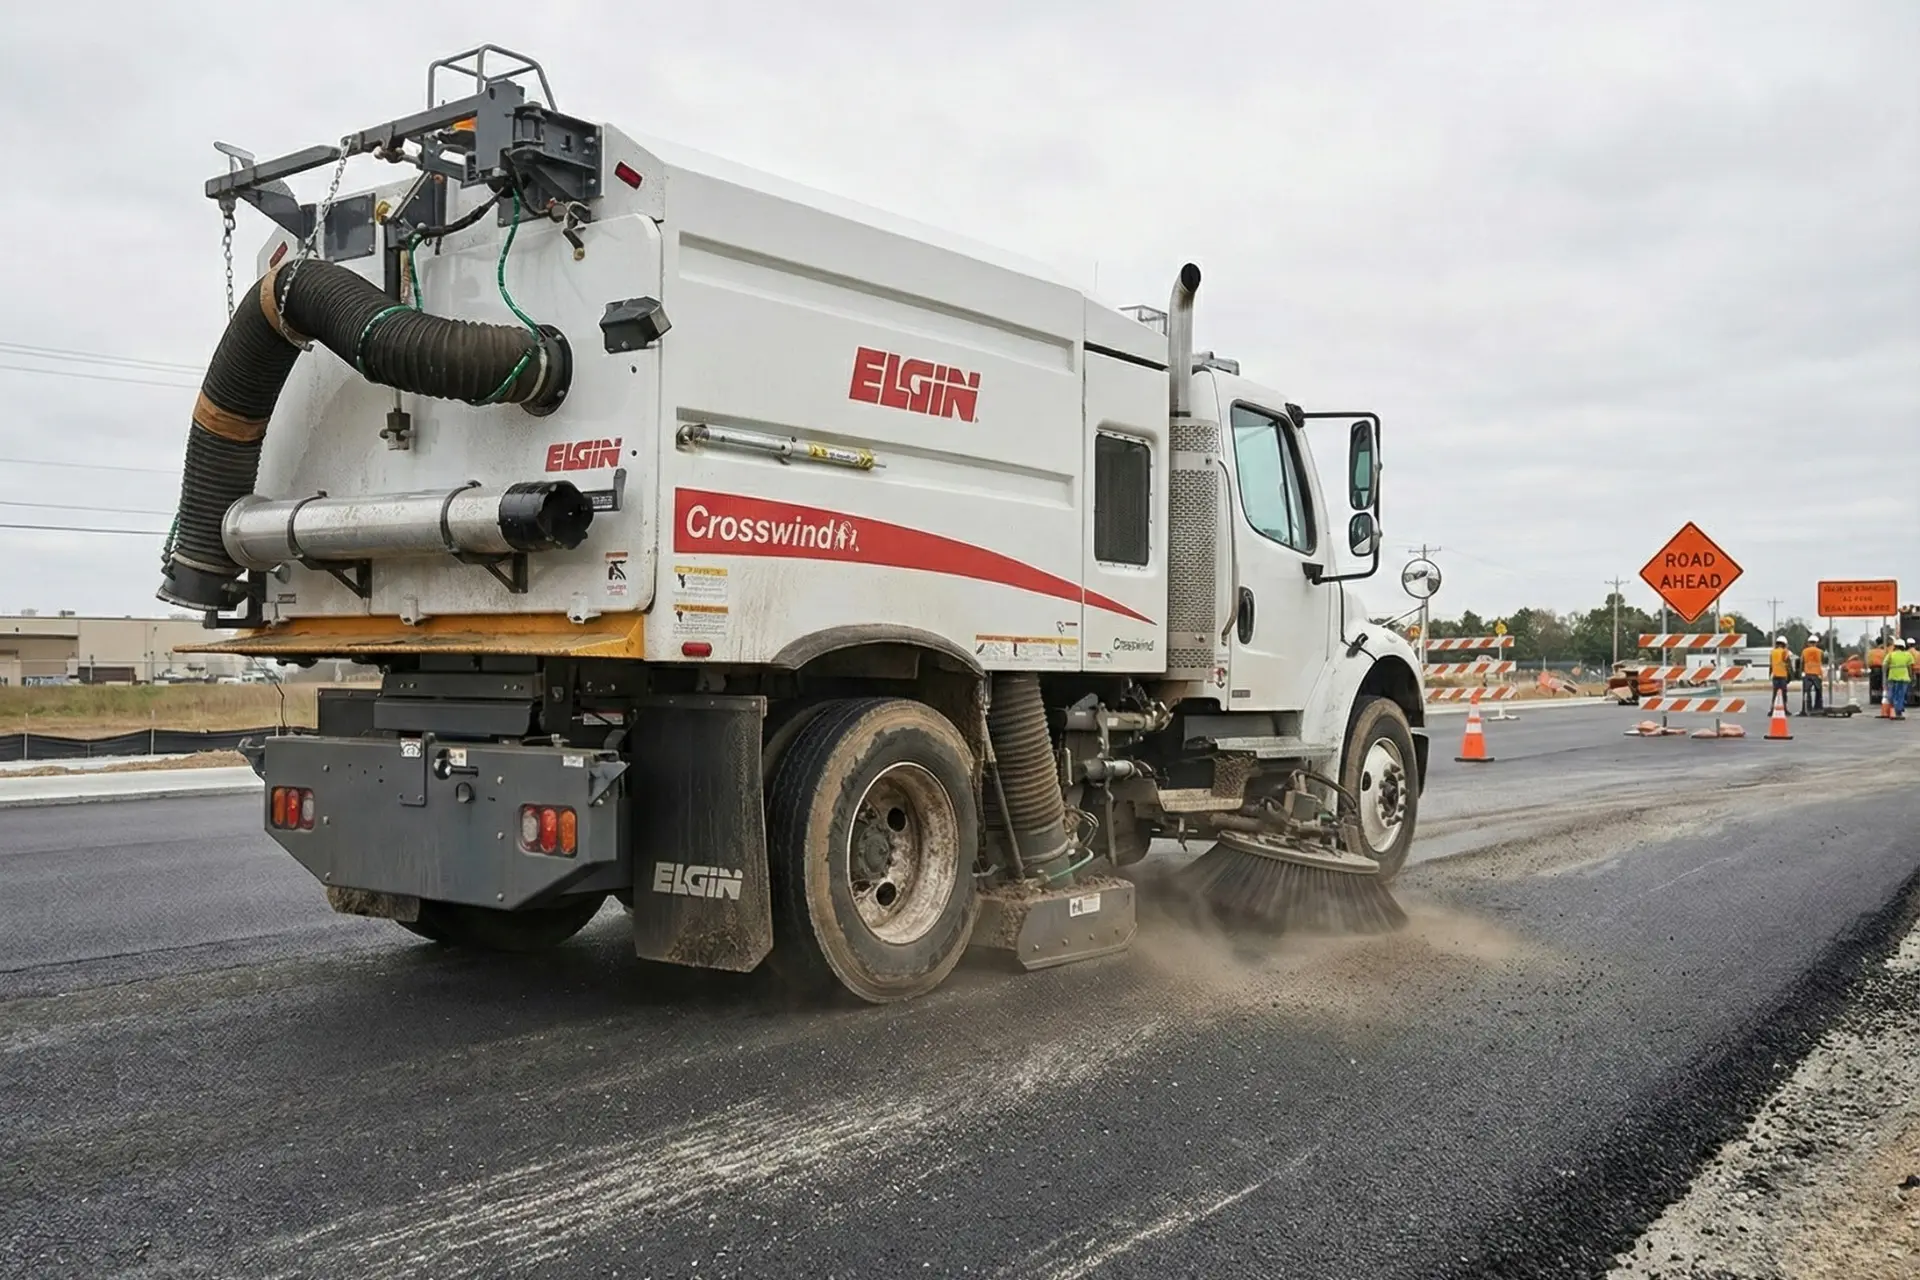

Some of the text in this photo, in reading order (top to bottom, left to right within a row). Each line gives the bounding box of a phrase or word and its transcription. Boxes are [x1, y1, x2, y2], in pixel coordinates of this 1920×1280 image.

[849, 346, 981, 423] ELGIN
[545, 438, 622, 472] ELGIN
[686, 504, 835, 549] Crosswind
[1665, 552, 1716, 568] ROAD
[1660, 574, 1722, 589] AHEAD
[653, 862, 743, 900] ELGIN
